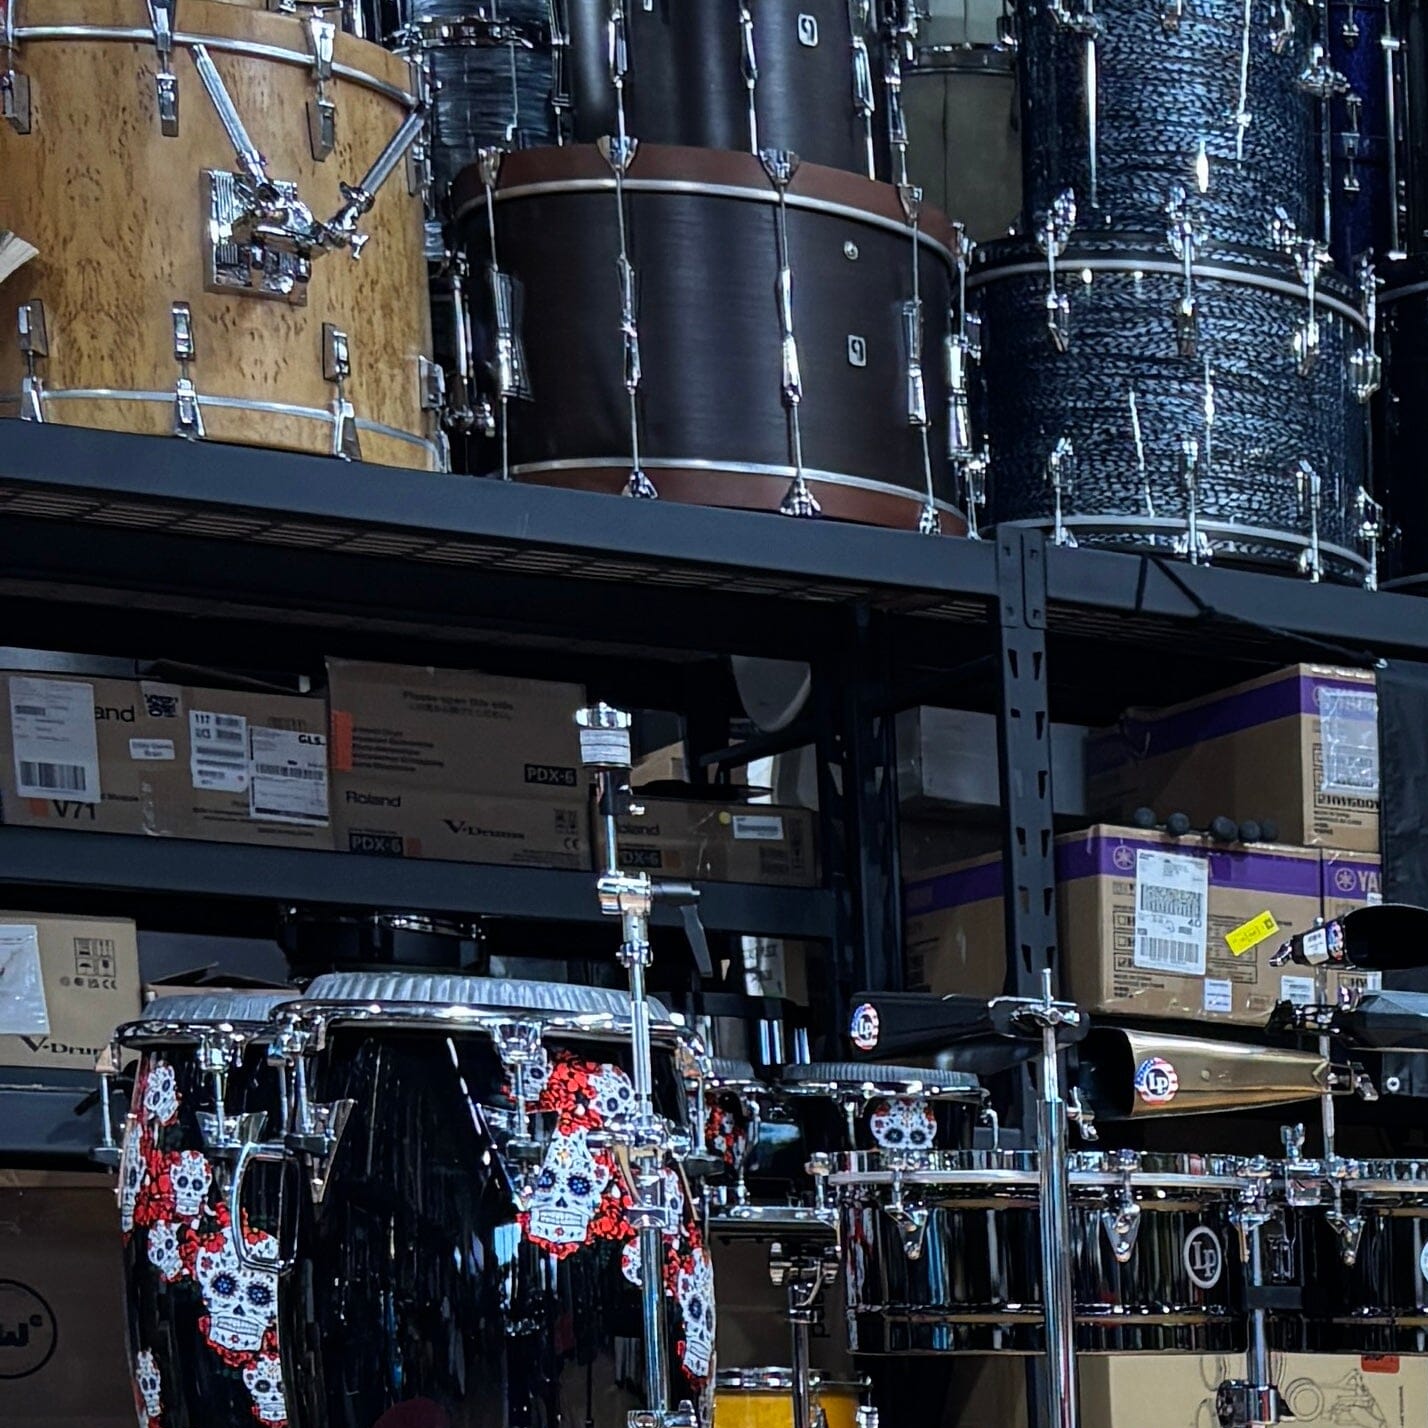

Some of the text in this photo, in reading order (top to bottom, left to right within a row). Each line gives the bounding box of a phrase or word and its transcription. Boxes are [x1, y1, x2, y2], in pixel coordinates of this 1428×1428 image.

[526, 767, 576, 786] PDX-6
[346, 790, 401, 808] Roland
[1191, 1240, 1217, 1278] LP
